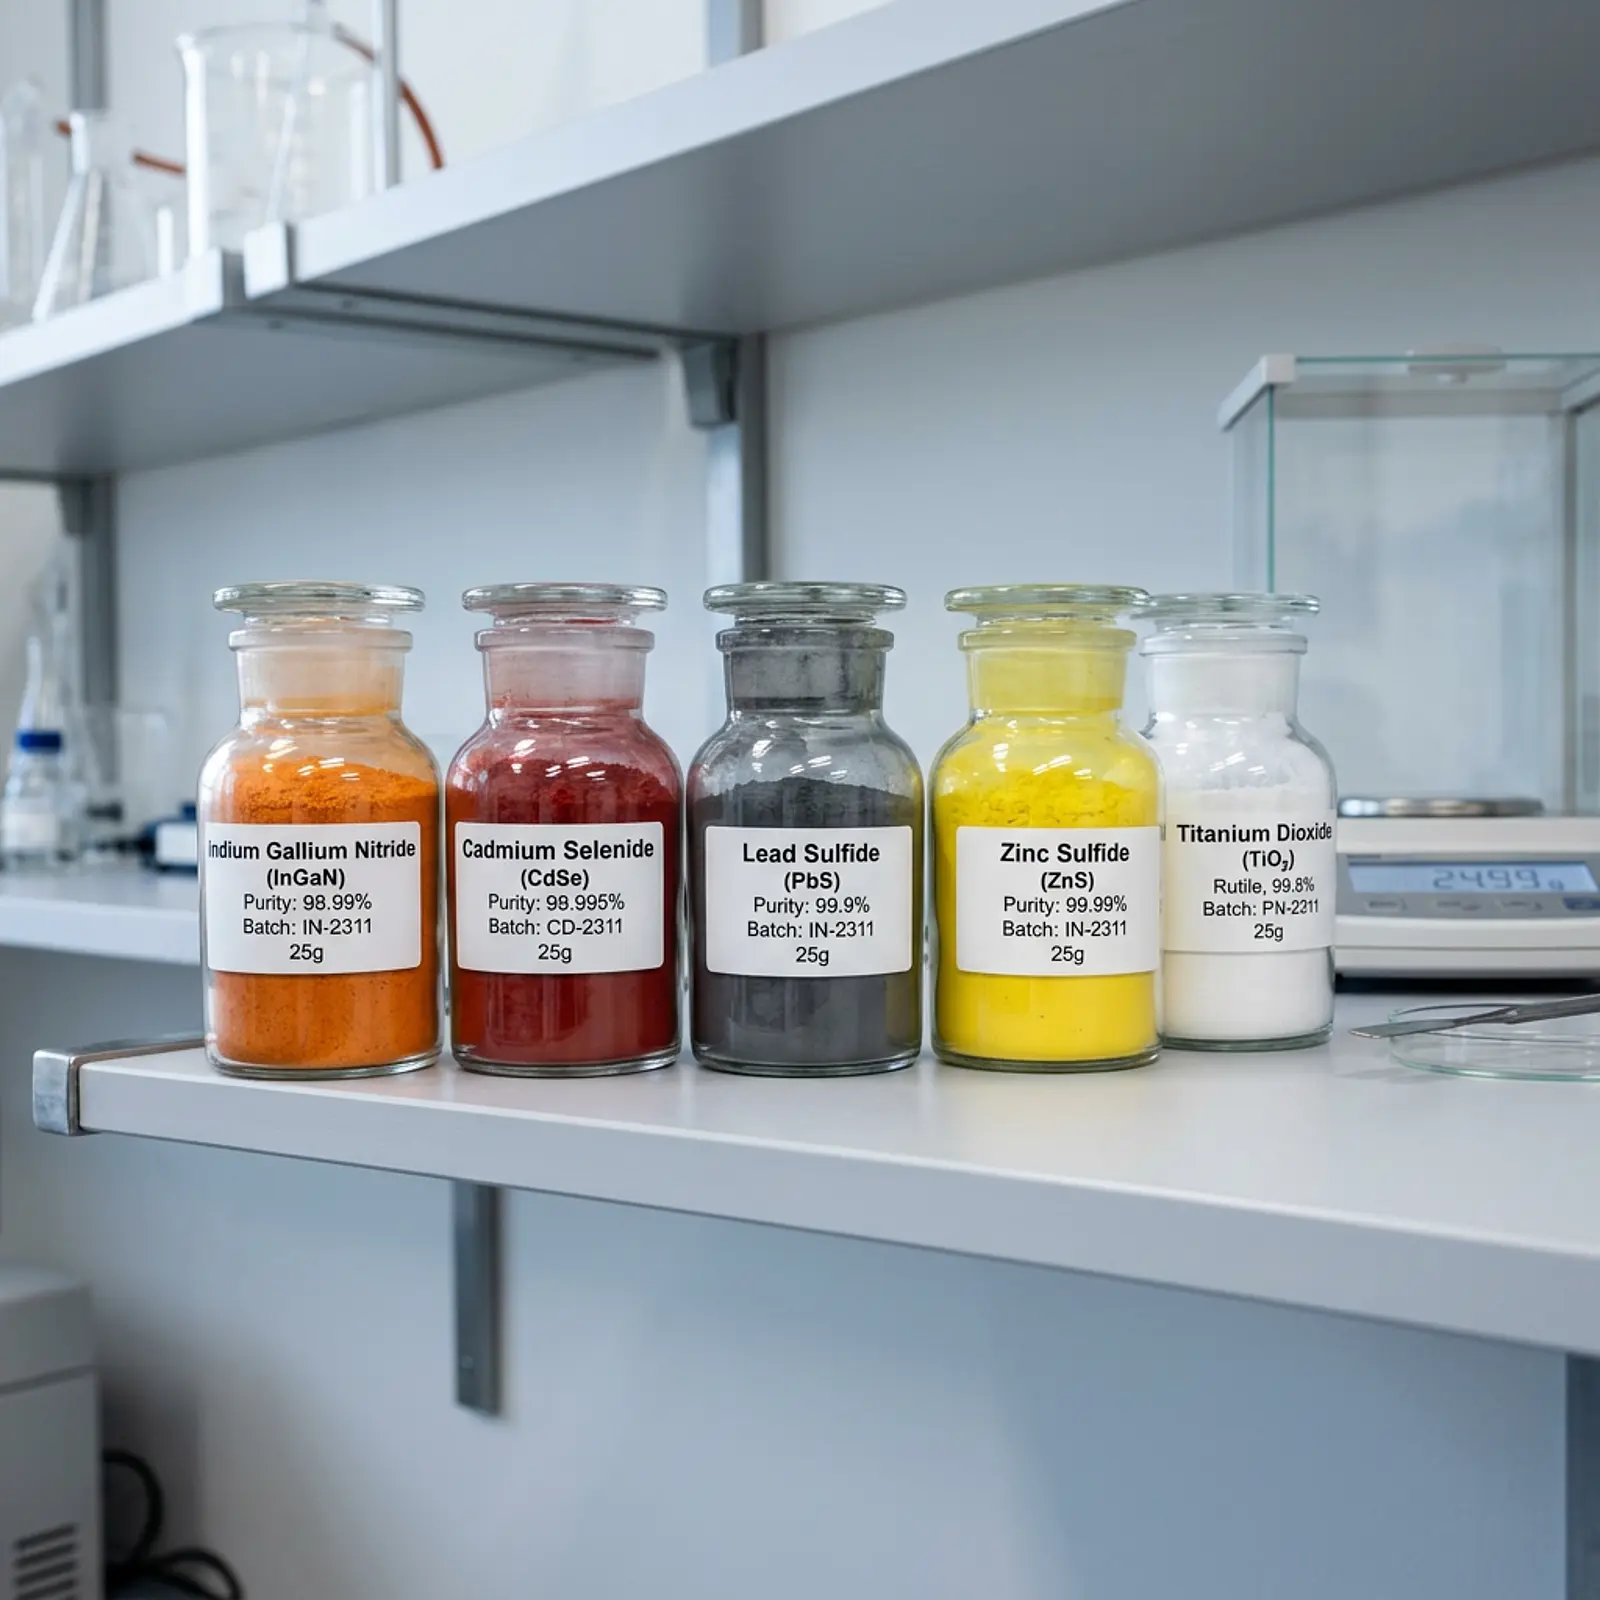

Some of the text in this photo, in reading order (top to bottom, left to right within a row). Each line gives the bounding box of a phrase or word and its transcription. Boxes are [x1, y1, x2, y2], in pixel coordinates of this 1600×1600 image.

[1176, 822, 1333, 843] Titanium Dioxide
[208, 839, 416, 861] Indium Gallium Nitride
[462, 838, 655, 861] Cadmium Selenide
[743, 842, 881, 864] Lead Sulfide
[999, 842, 1130, 864] Zinc Sulfide
[266, 868, 346, 891] (InGaN)
[520, 868, 590, 892] (CdSe)
[783, 871, 841, 894] (PbS)
[1040, 871, 1095, 894] (ZnS)
[1213, 876, 1315, 896] Rutile, 99.8%
[243, 892, 373, 915] Purity: 98.99%
[488, 892, 626, 915] Purity: 98.995%
[753, 895, 871, 919] Purity: 99.9%
[1003, 894, 1128, 918] Purity: 99.99%
[1202, 900, 1257, 917] Batch:
[243, 917, 372, 936] Batch: IN-2311
[488, 917, 622, 936] Batch: CD-2311
[747, 920, 873, 939] Batch: IN-2311
[1002, 919, 1126, 938] Batch: IN-2311
[1253, 922, 1284, 943] 25g
[289, 943, 324, 964] 25g
[537, 943, 573, 965] 25g
[795, 946, 830, 967] 25g
[1051, 944, 1085, 966] 25g
